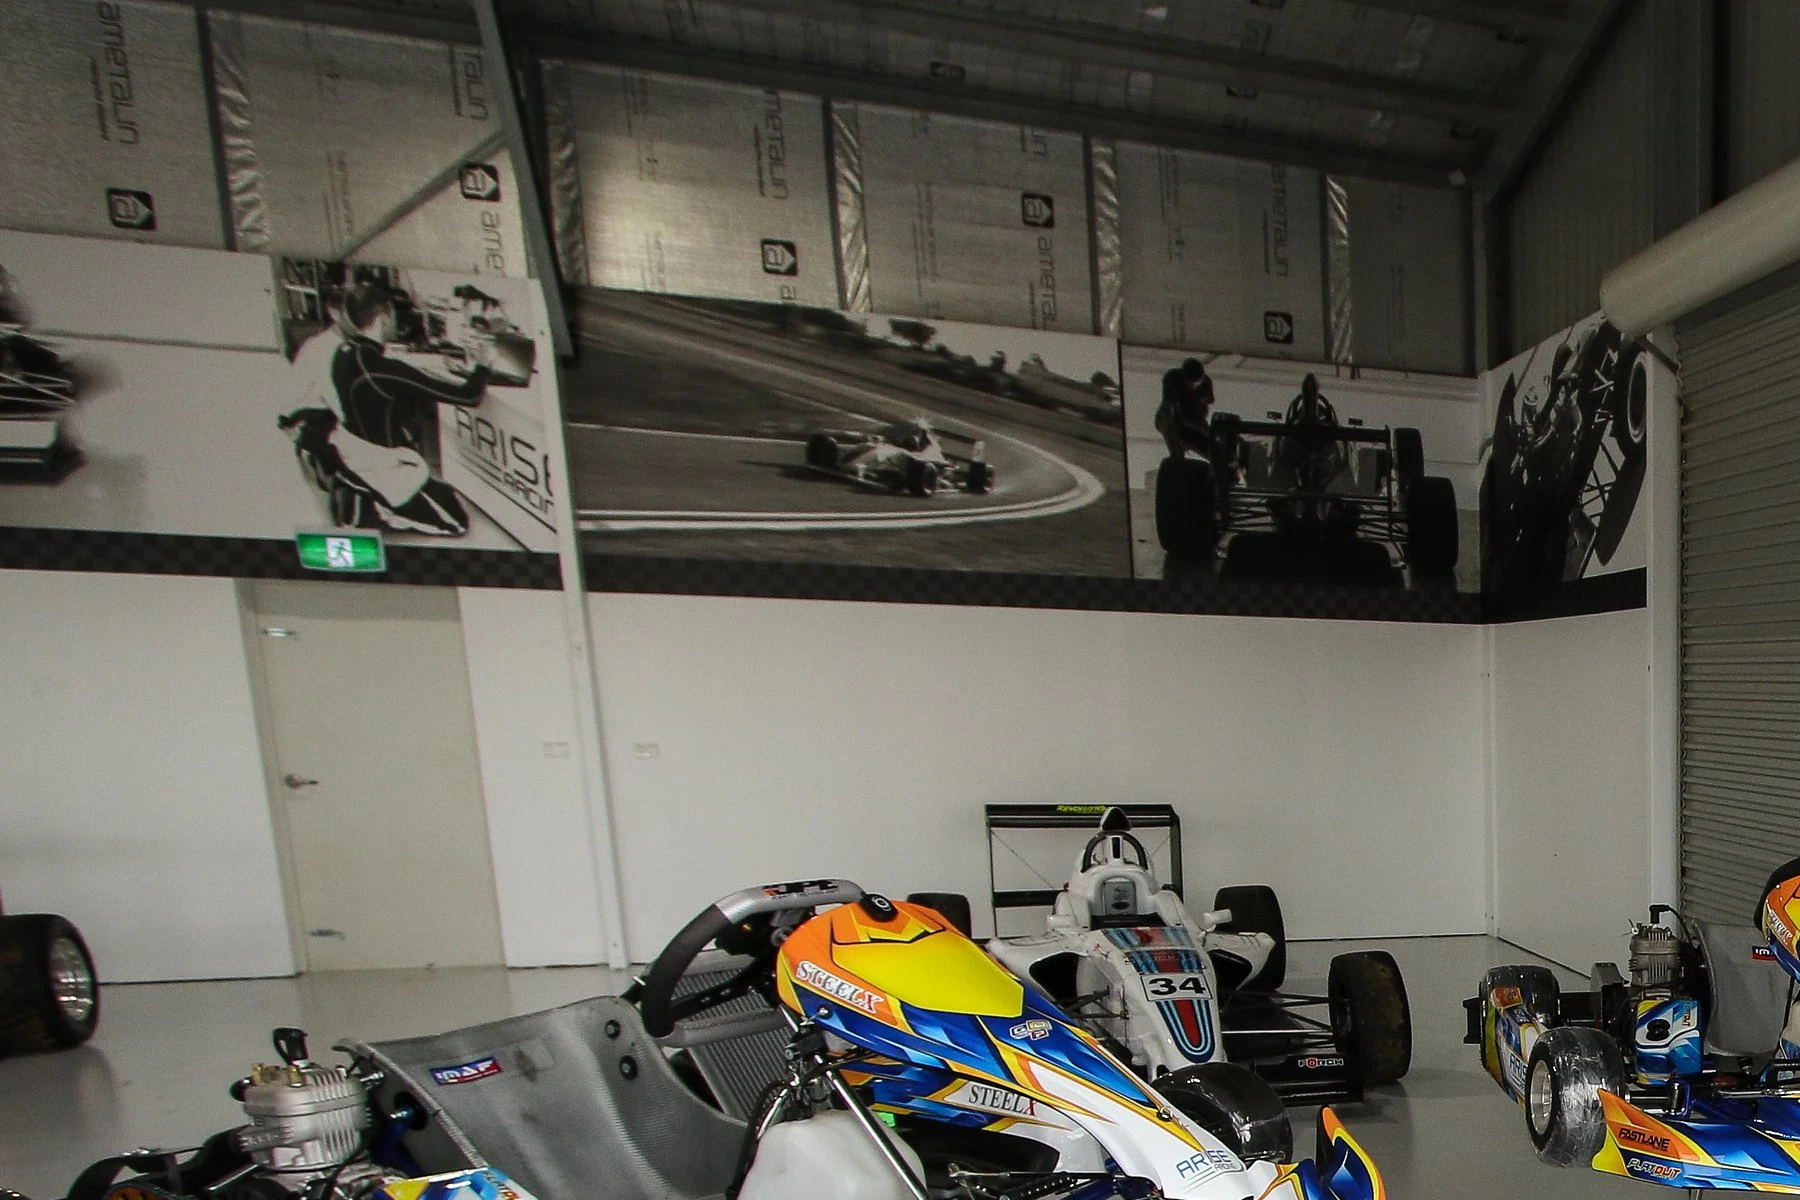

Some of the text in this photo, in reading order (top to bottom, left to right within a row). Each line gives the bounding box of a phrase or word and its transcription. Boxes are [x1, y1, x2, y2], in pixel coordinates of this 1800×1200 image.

[796, 961, 885, 1014] STEELX
[1149, 977, 1206, 995] 34
[967, 1082, 1040, 1118] STEELX
[1618, 1129, 1671, 1149] FASTLANE
[1176, 1150, 1229, 1179] ARISE
[1628, 1158, 1681, 1178] FLATOUT
